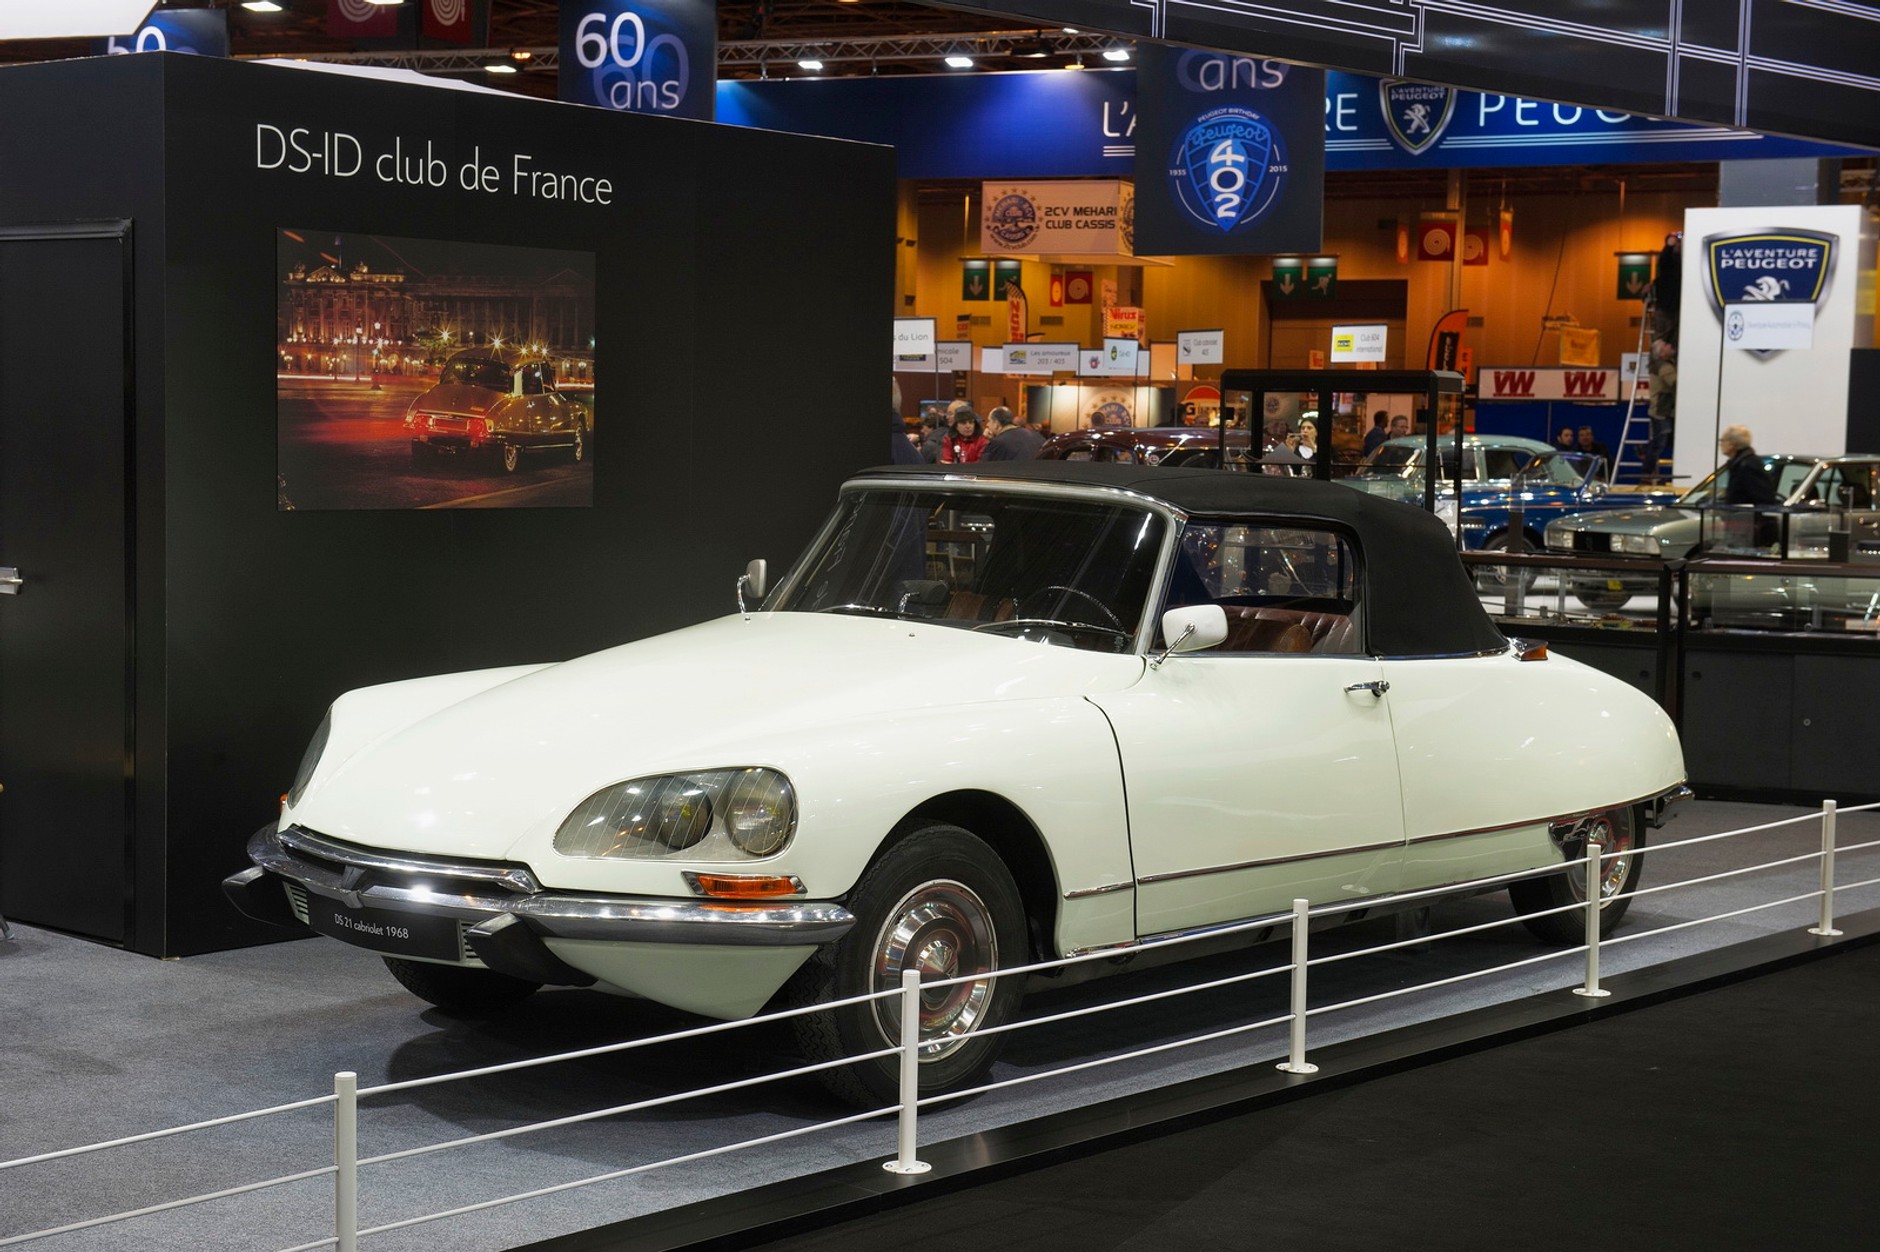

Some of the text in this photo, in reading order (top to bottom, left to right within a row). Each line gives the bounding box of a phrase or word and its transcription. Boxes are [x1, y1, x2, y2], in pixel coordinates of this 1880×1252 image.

[576, 12, 645, 68] 60
[1199, 57, 1284, 91] ans
[610, 79, 680, 110] ans
[1391, 92, 1445, 101] PEUGEOT
[1198, 107, 1260, 123] PEUGEOT BIRTHDAY
[257, 123, 613, 206] DS-ID club de France
[1268, 165, 1288, 173] 2015
[1210, 139, 1245, 218] 402
[1044, 206, 1117, 217] 2CV MEHARI
[1045, 219, 1116, 230] CLUB CASSIS
[1721, 248, 1818, 258] L'AVENTURE
[1721, 258, 1817, 269] PEUGEOT
[911, 332, 929, 341] Lion
[334, 913, 409, 939] DS 21 cabriolet 1968
